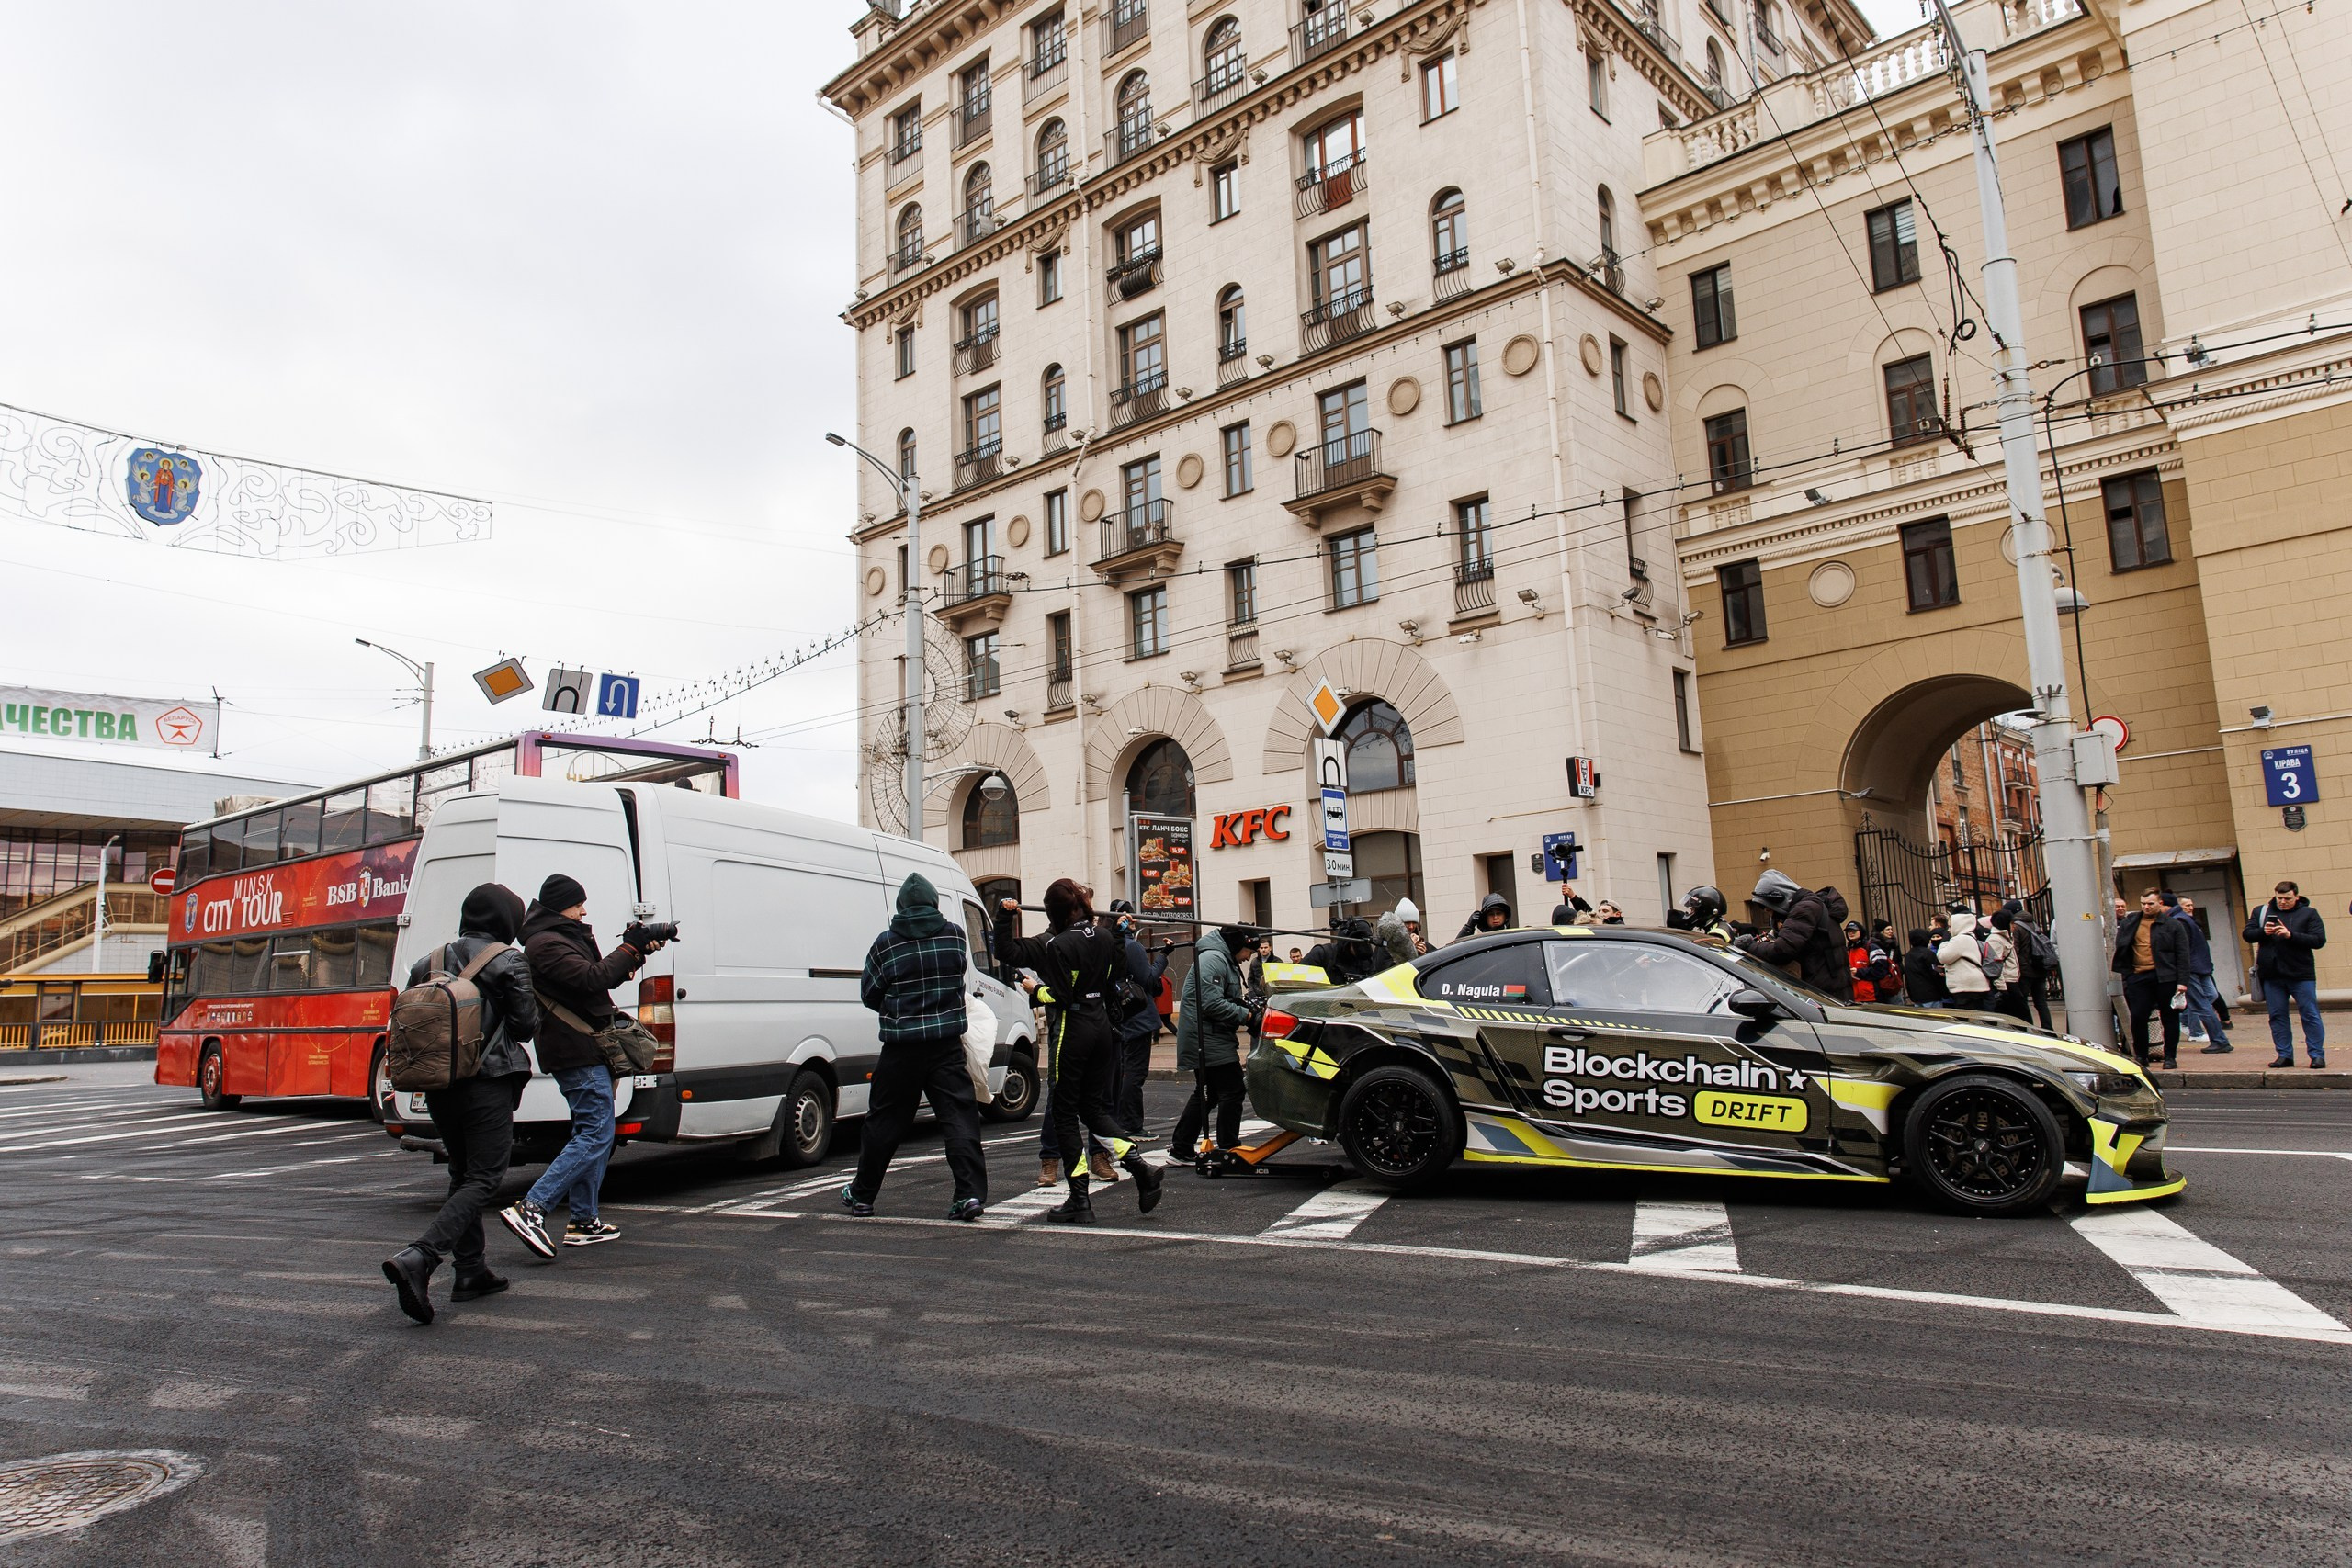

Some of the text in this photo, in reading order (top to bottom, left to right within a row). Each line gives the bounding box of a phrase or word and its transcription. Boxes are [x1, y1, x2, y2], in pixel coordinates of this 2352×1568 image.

[0, 702, 138, 741] ЧЕСТВА
[163, 715, 197, 725] БЕЛАРУСЬ
[2274, 758, 2301, 769] КІРАВА
[2286, 748, 2309, 756] ВУЛІЦА
[1580, 786, 1592, 795] KFC
[2280, 772, 2301, 799] 3
[1170, 825, 1189, 833] БОКС
[1209, 805, 1291, 848] KFC
[1326, 859, 1337, 871] 30
[233, 873, 275, 899] MINSK
[326, 874, 411, 906] BSB Bank
[203, 891, 283, 933] CITY TOUR
[1441, 983, 1500, 998] D. Nagula
[1543, 1045, 1778, 1089] Blockchain
[1543, 1079, 1792, 1123] Sports DRIFT
